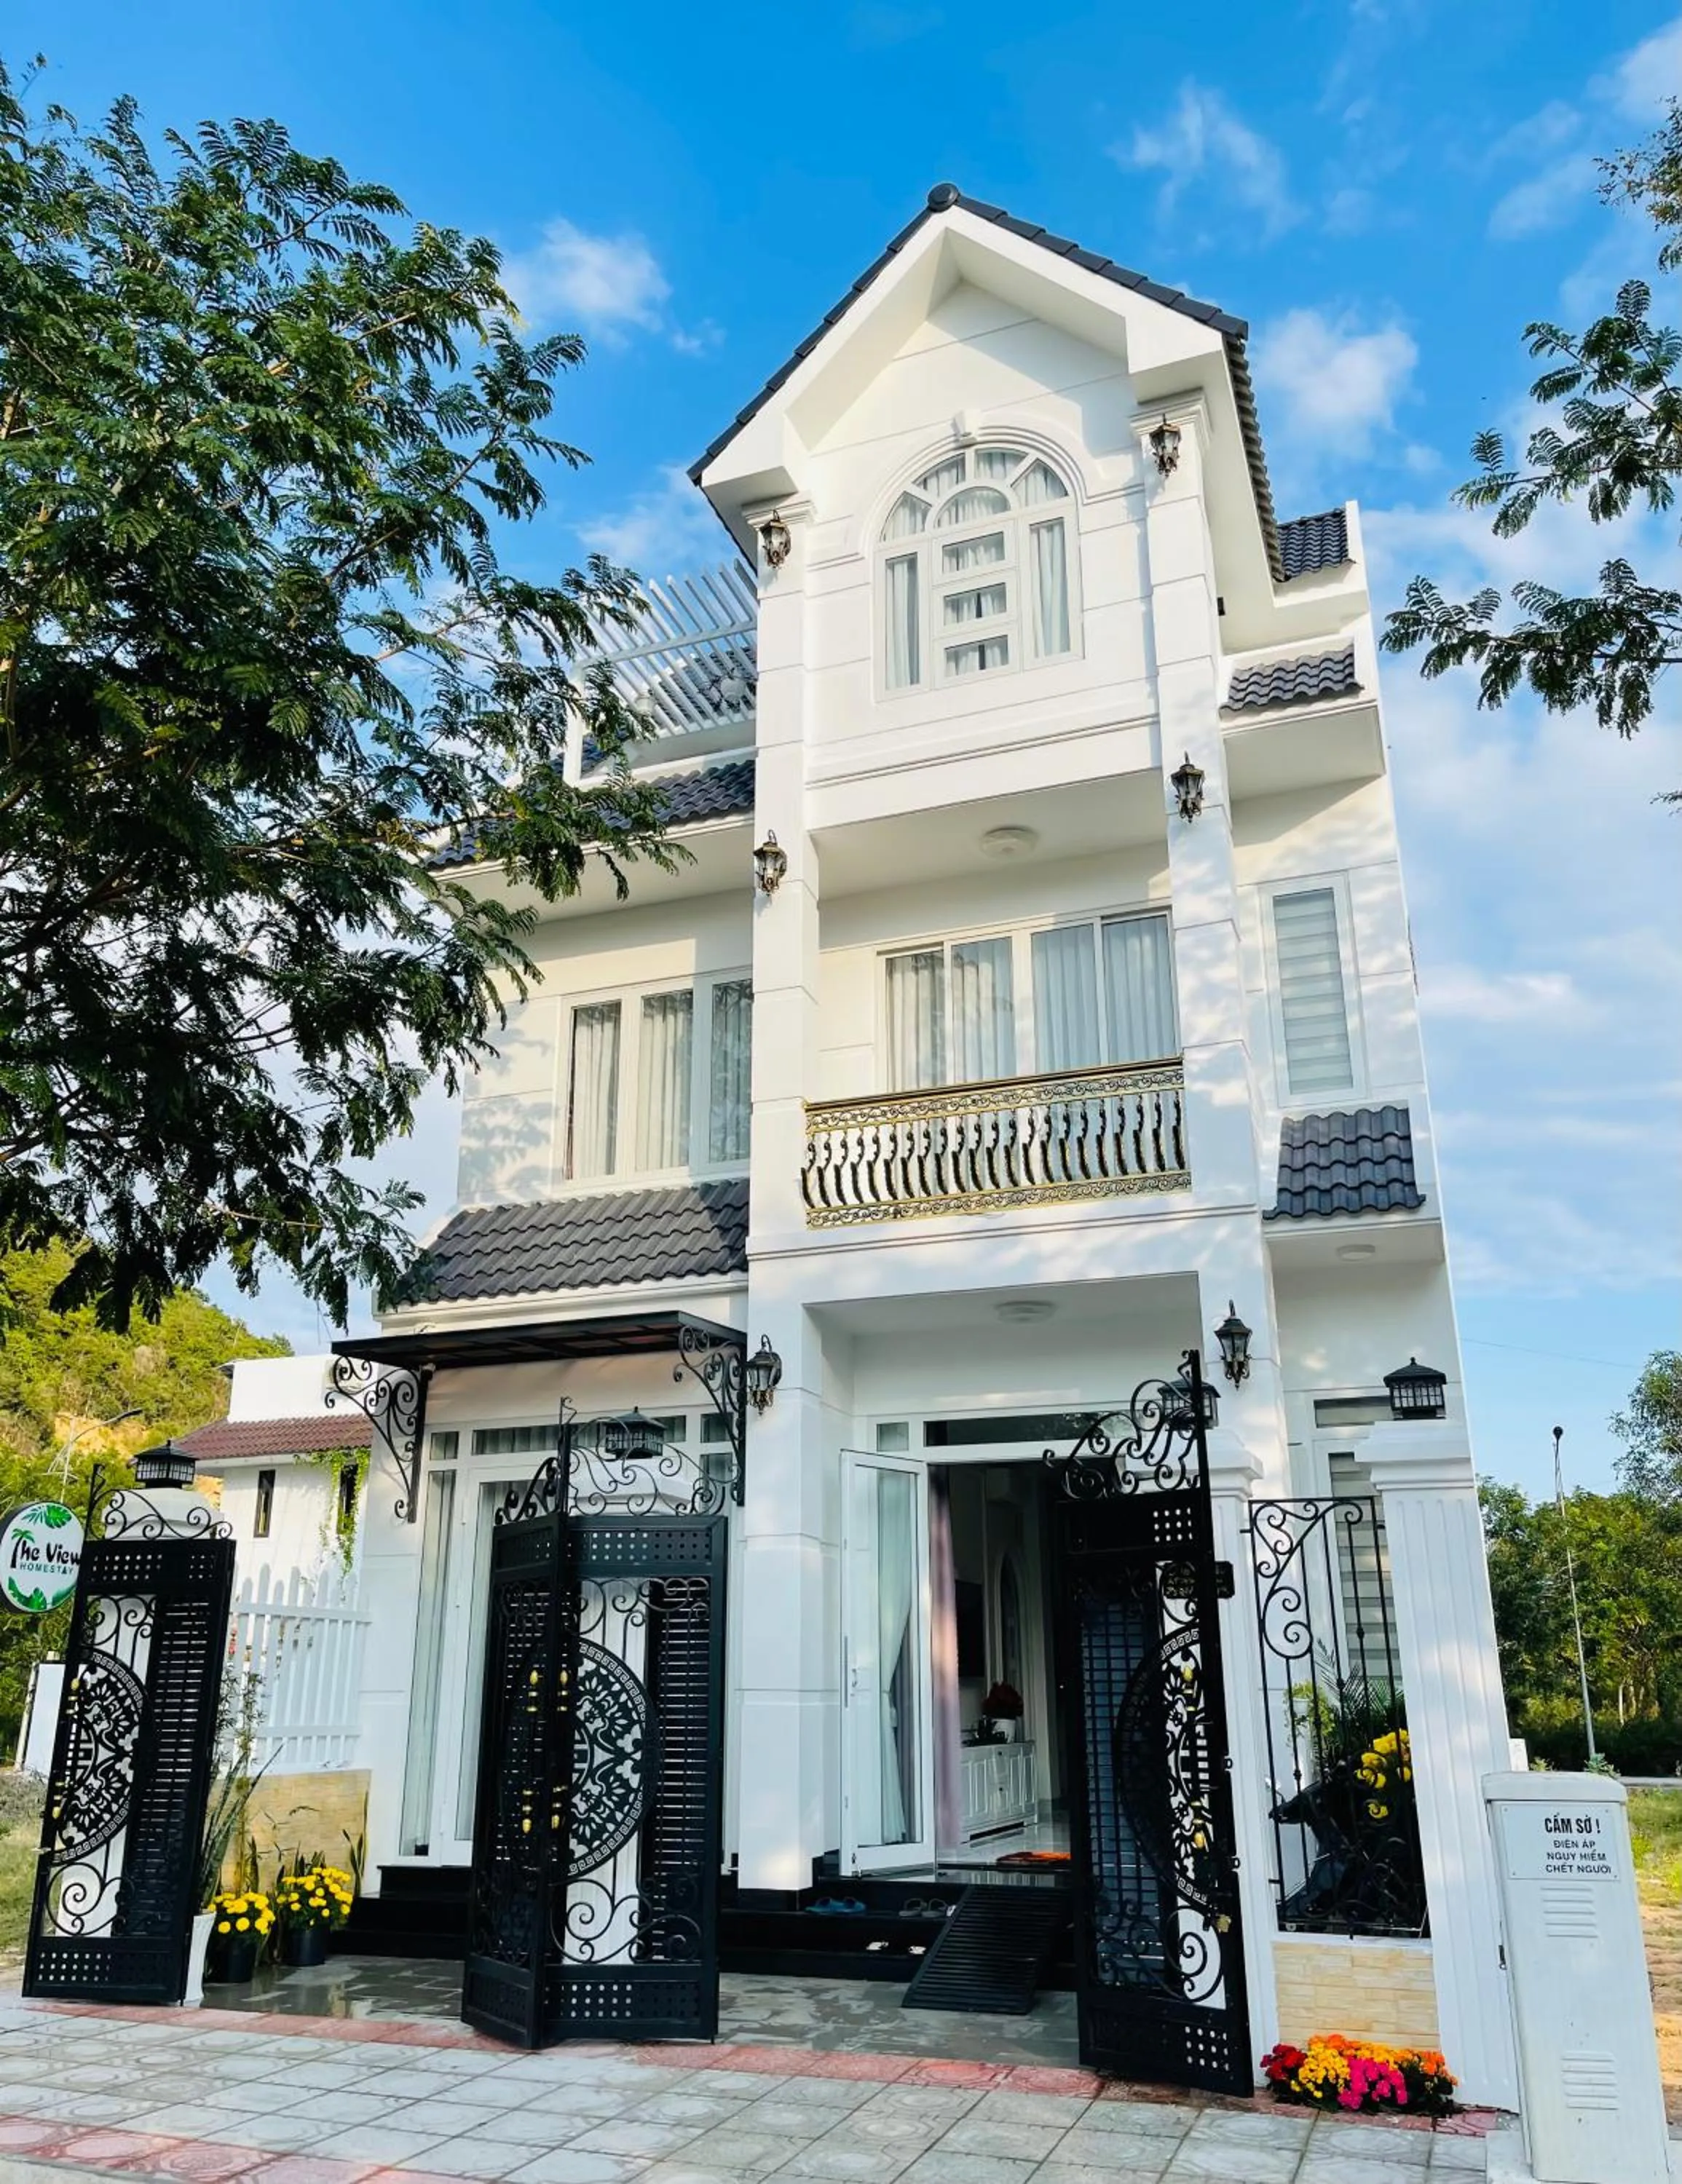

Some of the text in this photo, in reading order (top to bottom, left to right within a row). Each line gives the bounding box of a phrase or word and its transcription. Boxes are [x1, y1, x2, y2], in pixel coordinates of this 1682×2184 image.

[46, 1542, 81, 1565] View
[20, 1562, 74, 1574] HOMESTAY
[1544, 1812, 1573, 1834] CẤM
[1582, 1839, 1596, 1848] ÁP
[1546, 1851, 1576, 1861] NGUY
[1545, 1861, 1574, 1874] CHẾT
